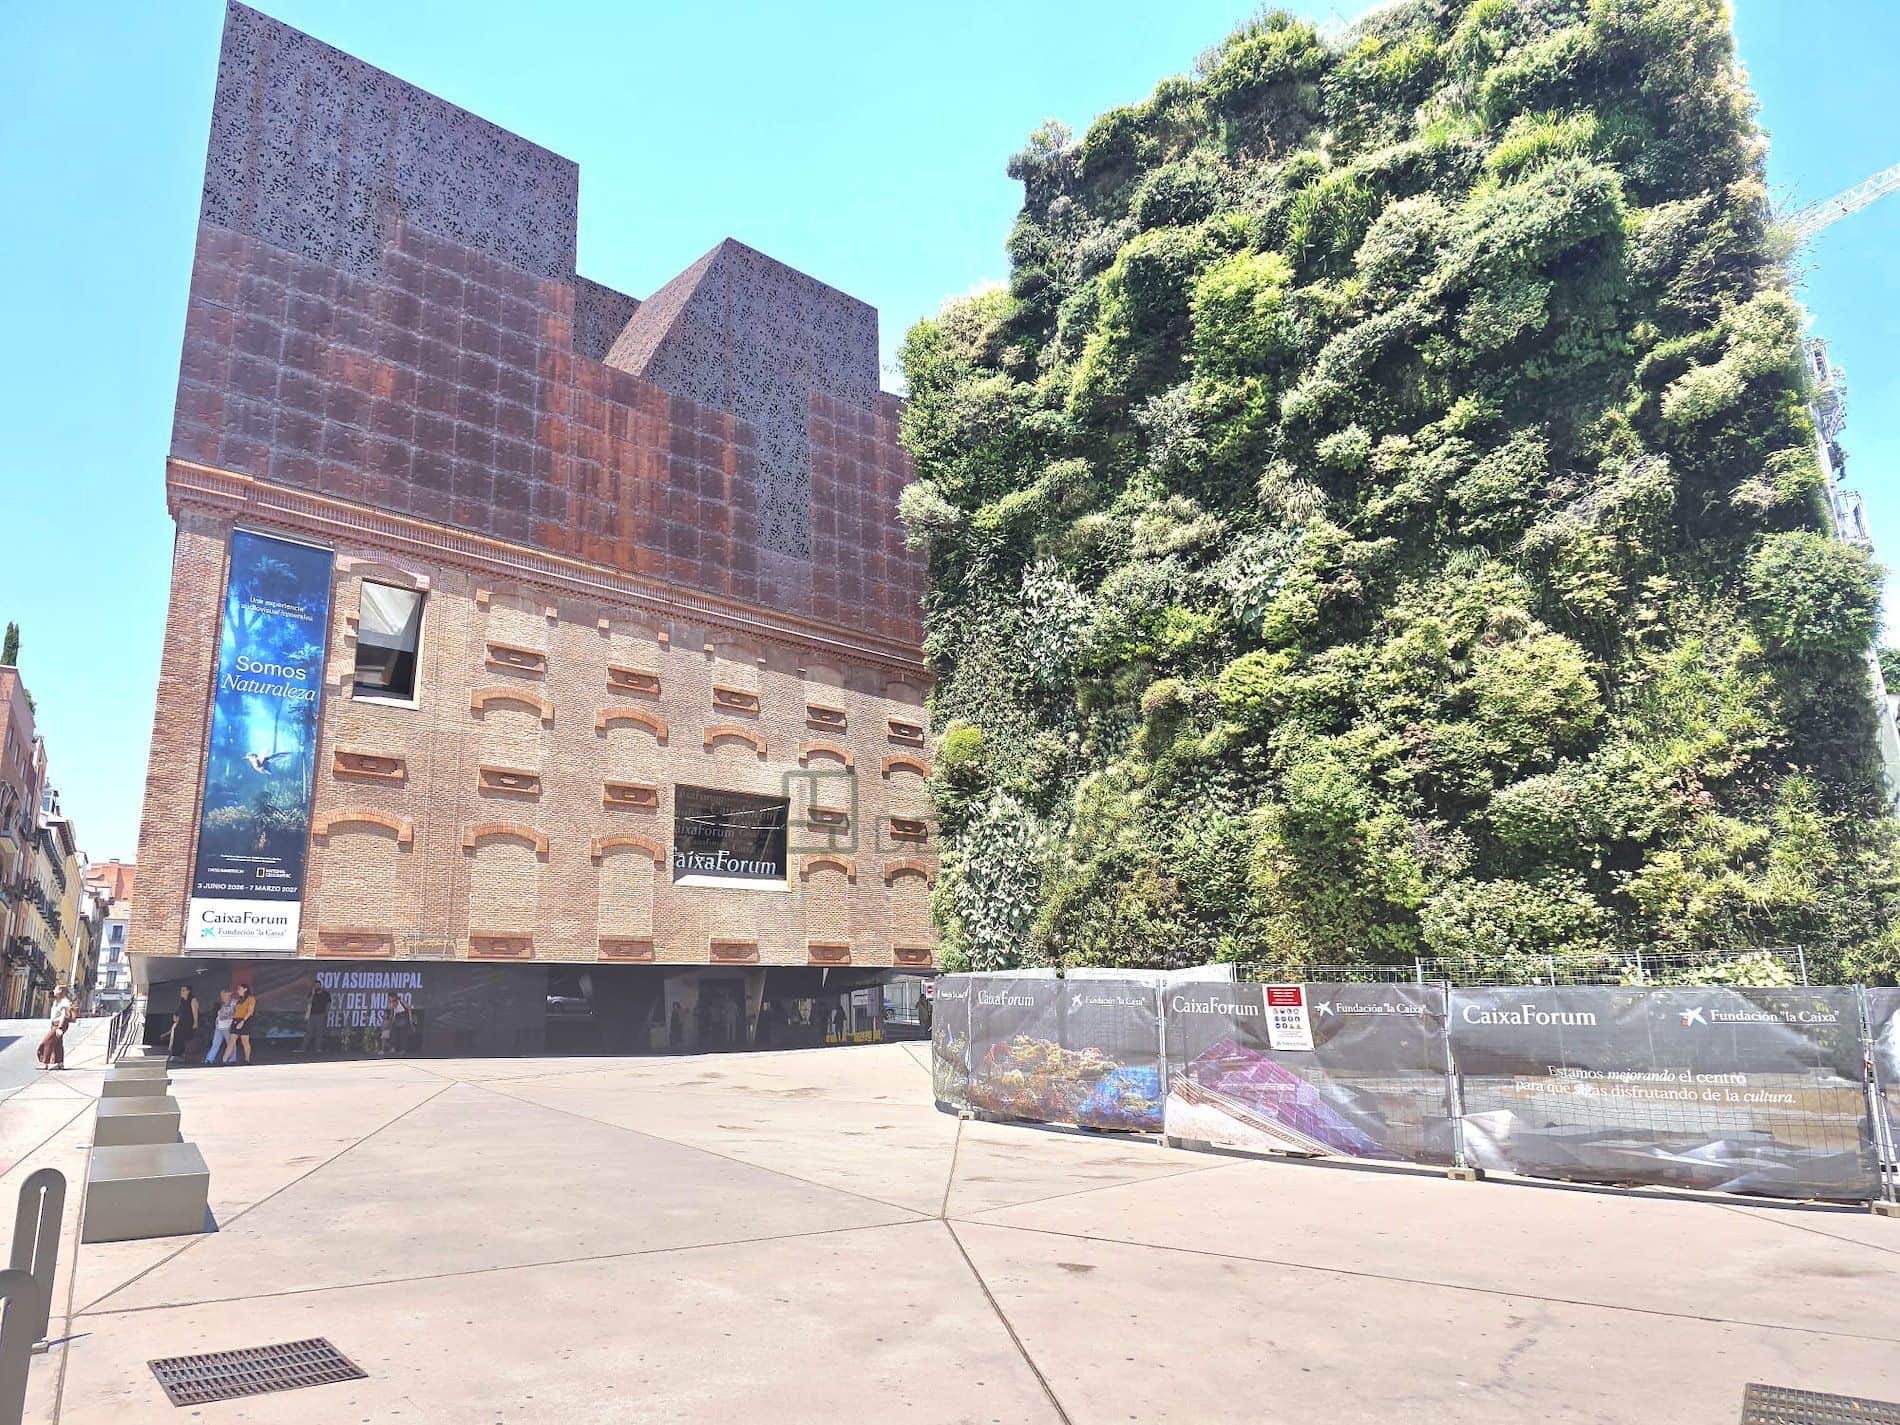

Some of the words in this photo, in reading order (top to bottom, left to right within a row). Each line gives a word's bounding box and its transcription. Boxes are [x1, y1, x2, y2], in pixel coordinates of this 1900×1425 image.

[236, 655, 307, 680] Somos
[221, 673, 316, 701] Naturaleza
[202, 910, 288, 925] CaixaForum
[316, 972, 340, 989] SOY
[342, 972, 423, 989] ASURBANIPAL
[330, 993, 345, 1010] EY
[346, 993, 368, 1009] DEL
[370, 993, 414, 1009] MUO.
[978, 990, 1034, 1006] CaixaForum
[1172, 996, 1259, 1017] CaixaForum
[1336, 1002, 1383, 1013] Fundación
[1462, 1004, 1597, 1027] CaixaForum
[1710, 1009, 1778, 1022] Fundación
[1780, 1010, 1796, 1022] "la
[1798, 1010, 1839, 1022] Caixa"
[327, 1010, 350, 1027] REY
[351, 1010, 367, 1027] DE
[1546, 1065, 1605, 1080] Estamos
[1607, 1068, 1676, 1083] mejorando
[1679, 1069, 1692, 1081] el
[1696, 1071, 1748, 1084] centro
[1515, 1080, 1544, 1092] para
[1547, 1082, 1571, 1095] que
[1610, 1085, 1698, 1101] disfrutando
[1702, 1088, 1721, 1101] de
[1725, 1088, 1739, 1102] la
[1743, 1090, 1797, 1104] cultura.
